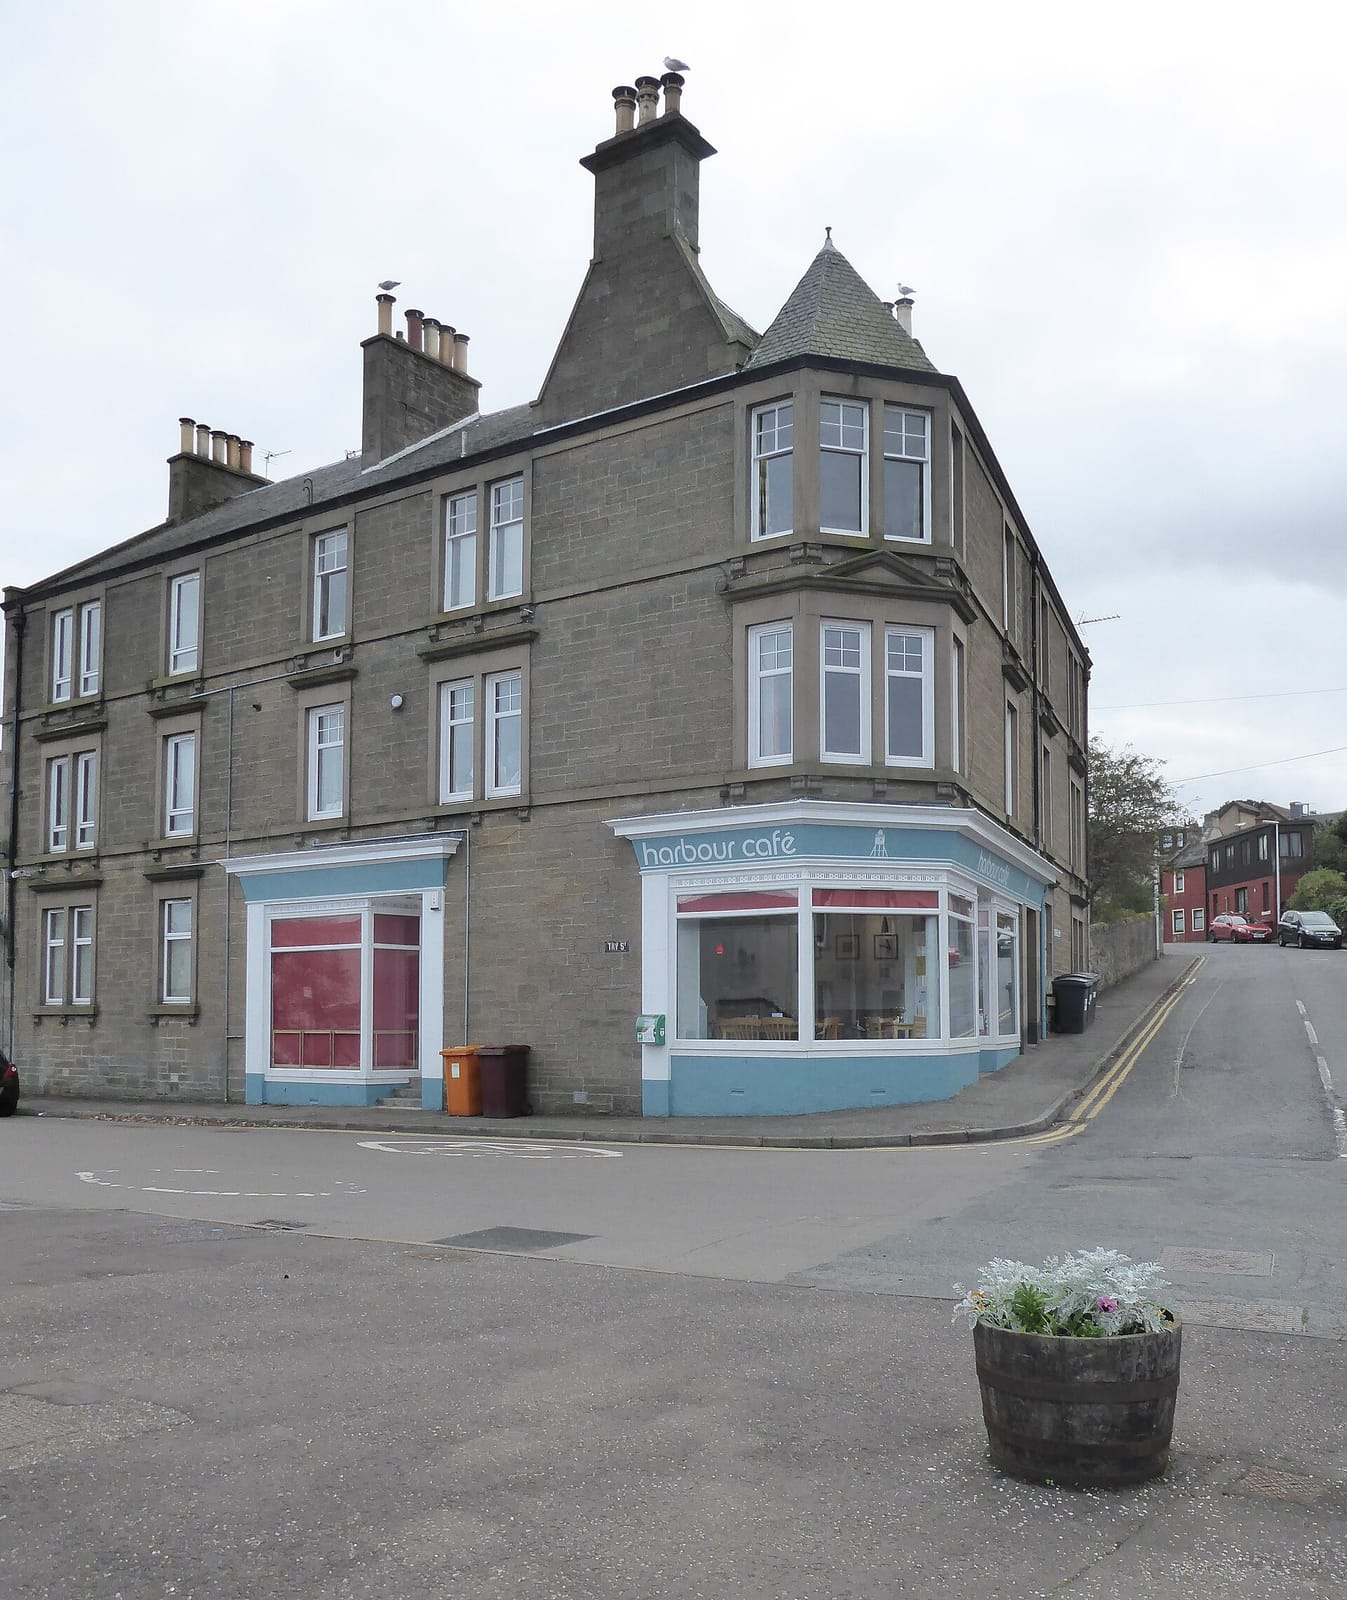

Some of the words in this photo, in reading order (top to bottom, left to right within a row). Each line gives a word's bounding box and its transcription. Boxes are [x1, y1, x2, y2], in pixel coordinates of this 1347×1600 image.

[642, 838, 735, 865] harbour
[742, 829, 796, 857] café
[607, 941, 619, 951] TAY
